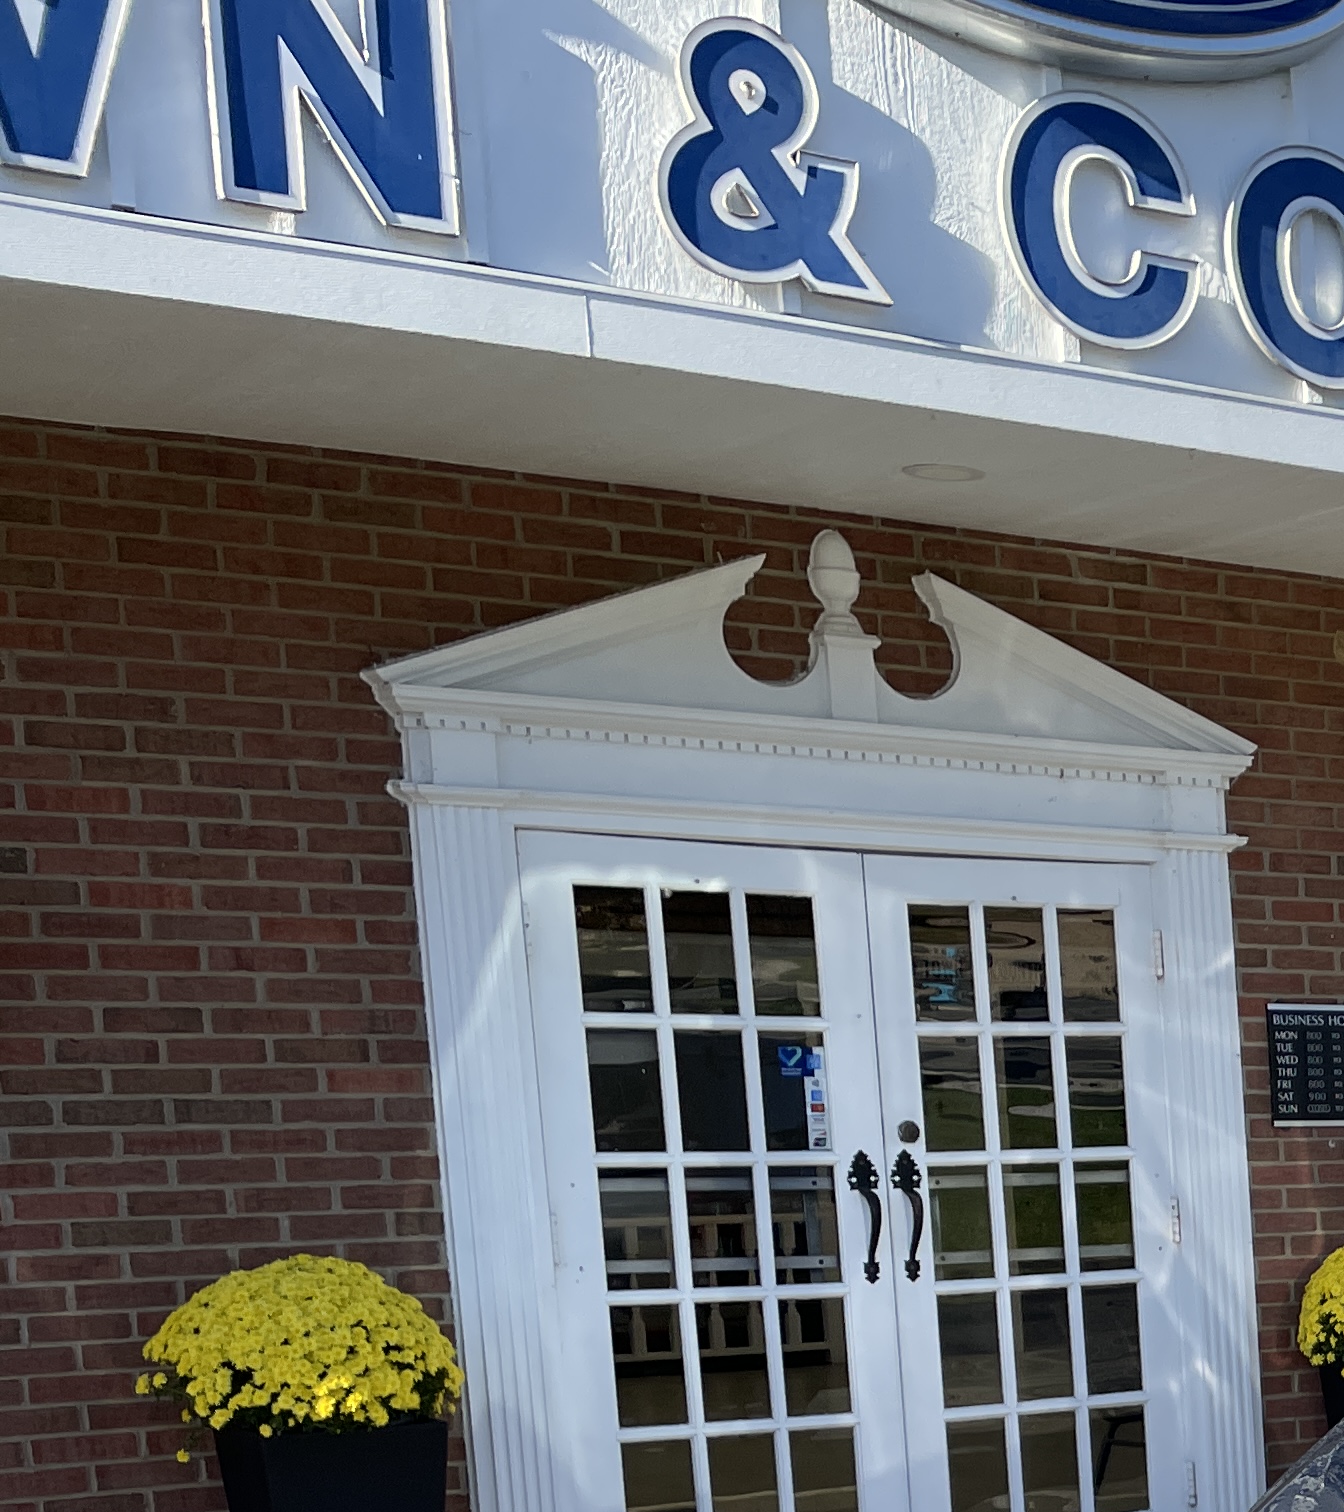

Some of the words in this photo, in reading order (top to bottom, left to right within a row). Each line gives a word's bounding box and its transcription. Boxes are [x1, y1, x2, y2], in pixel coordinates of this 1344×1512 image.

[657, 15, 893, 306] &
[1272, 1014, 1324, 1026] BUSINESS
[1274, 1030, 1298, 1040] MON
[1276, 1042, 1293, 1053] TUE
[1276, 1055, 1299, 1065] WED
[1277, 1067, 1297, 1077] THU
[1277, 1080, 1292, 1089] FRI
[1278, 1091, 1294, 1101] SAT
[1278, 1104, 1298, 1113] SUN
